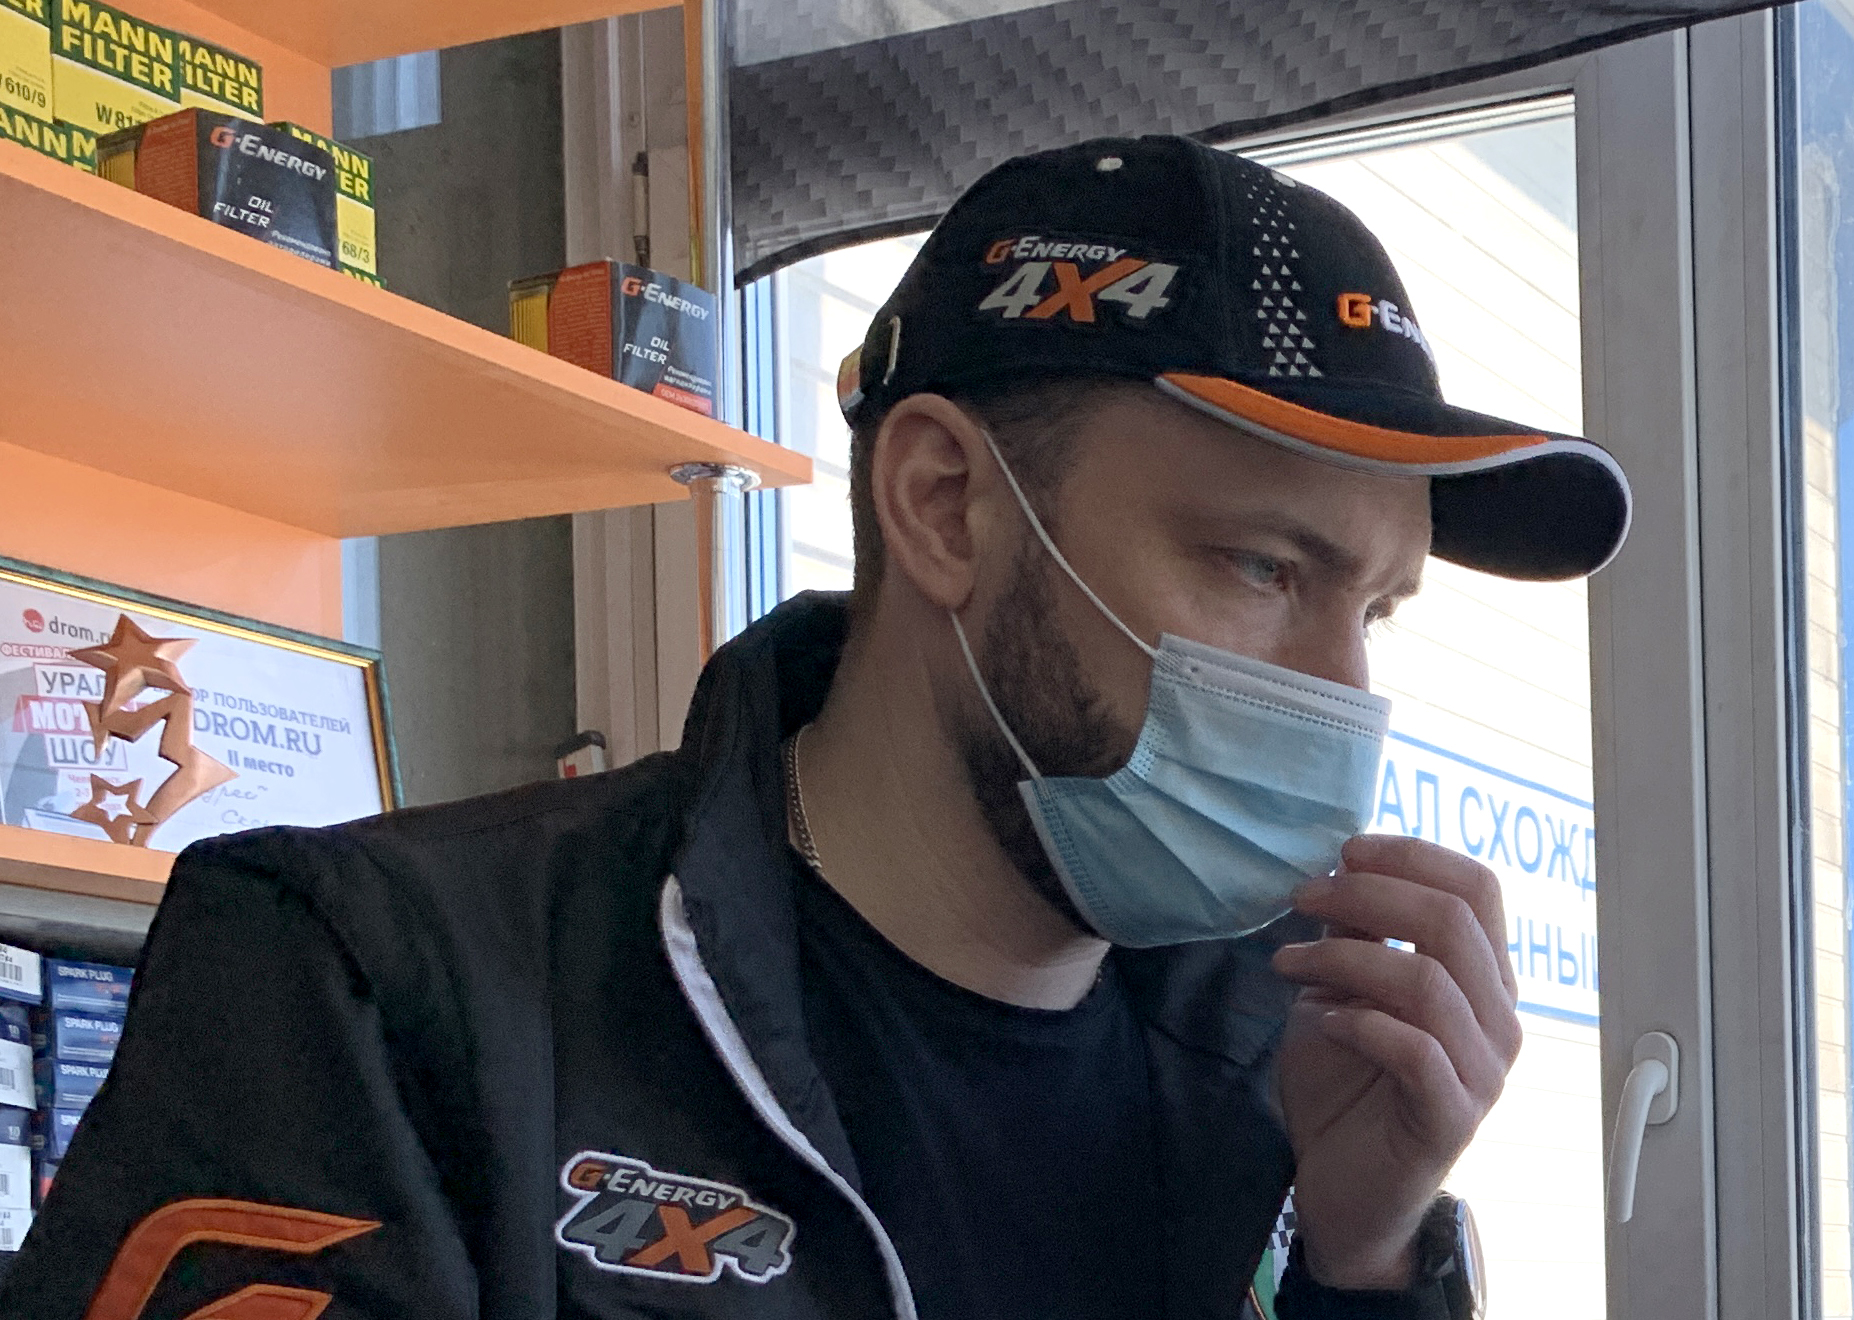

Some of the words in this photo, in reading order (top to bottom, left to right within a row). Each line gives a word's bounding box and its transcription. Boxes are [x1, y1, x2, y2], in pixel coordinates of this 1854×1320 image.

[62, 0, 173, 64] MANN
[62, 25, 173, 93] FILTER
[5, 76, 47, 109] 610/9
[180, 61, 259, 111] ILTER
[209, 125, 327, 182] G-ENERGY
[213, 201, 271, 229] FILTER
[248, 195, 274, 213] OIL
[985, 236, 1127, 264] G-ENERGY
[621, 276, 709, 320] G-ENERGY
[978, 260, 1180, 323] 4X4
[650, 336, 670, 351] OIL
[1337, 292, 1432, 362] G-EN
[623, 343, 668, 365] FILTER
[49, 616, 112, 645] drom.r
[29, 700, 92, 732] МОТ
[193, 708, 322, 757] DROM.RU
[213, 692, 351, 735] ПОЛЬЗОВАТЕЛЕЙ
[243, 755, 295, 778] место
[568, 1158, 737, 1210] G-ENERGY
[566, 1201, 785, 1274] 4X4
